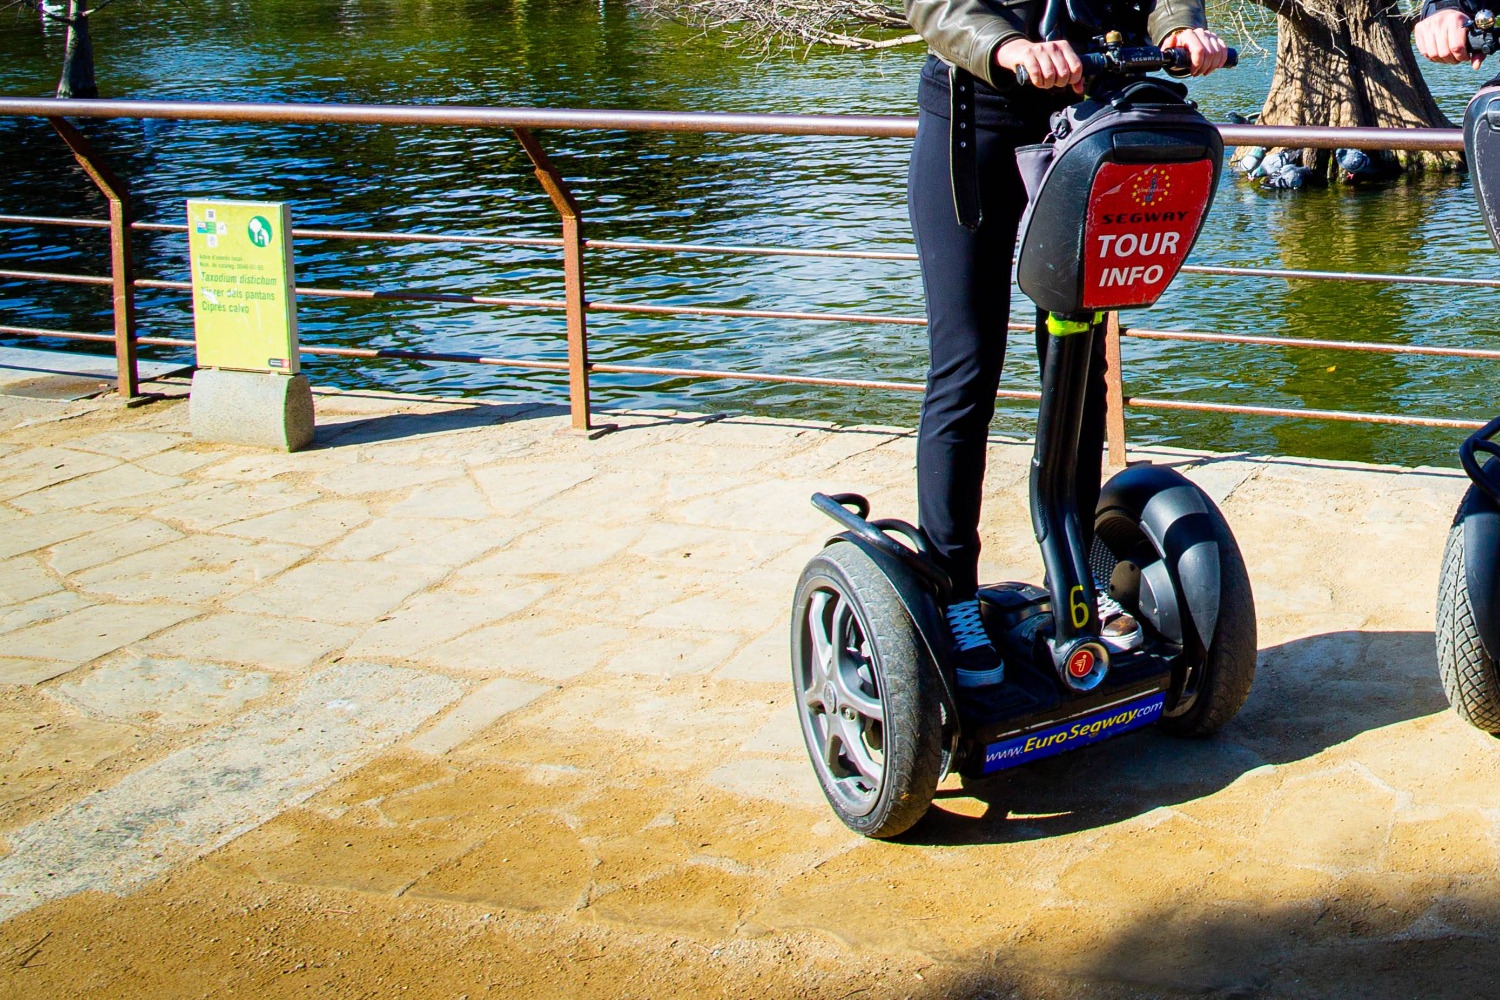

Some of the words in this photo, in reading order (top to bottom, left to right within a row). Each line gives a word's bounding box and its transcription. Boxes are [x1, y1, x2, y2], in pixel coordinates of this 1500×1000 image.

[1101, 211, 1189, 225] SEGWAY
[1098, 232, 1180, 258] TOUR
[201, 271, 238, 283] Taxodium
[239, 273, 277, 286] distichum
[1099, 265, 1163, 287] INFO
[245, 290, 276, 301] pantans
[229, 302, 249, 314] calvo
[1069, 585, 1090, 628] 6
